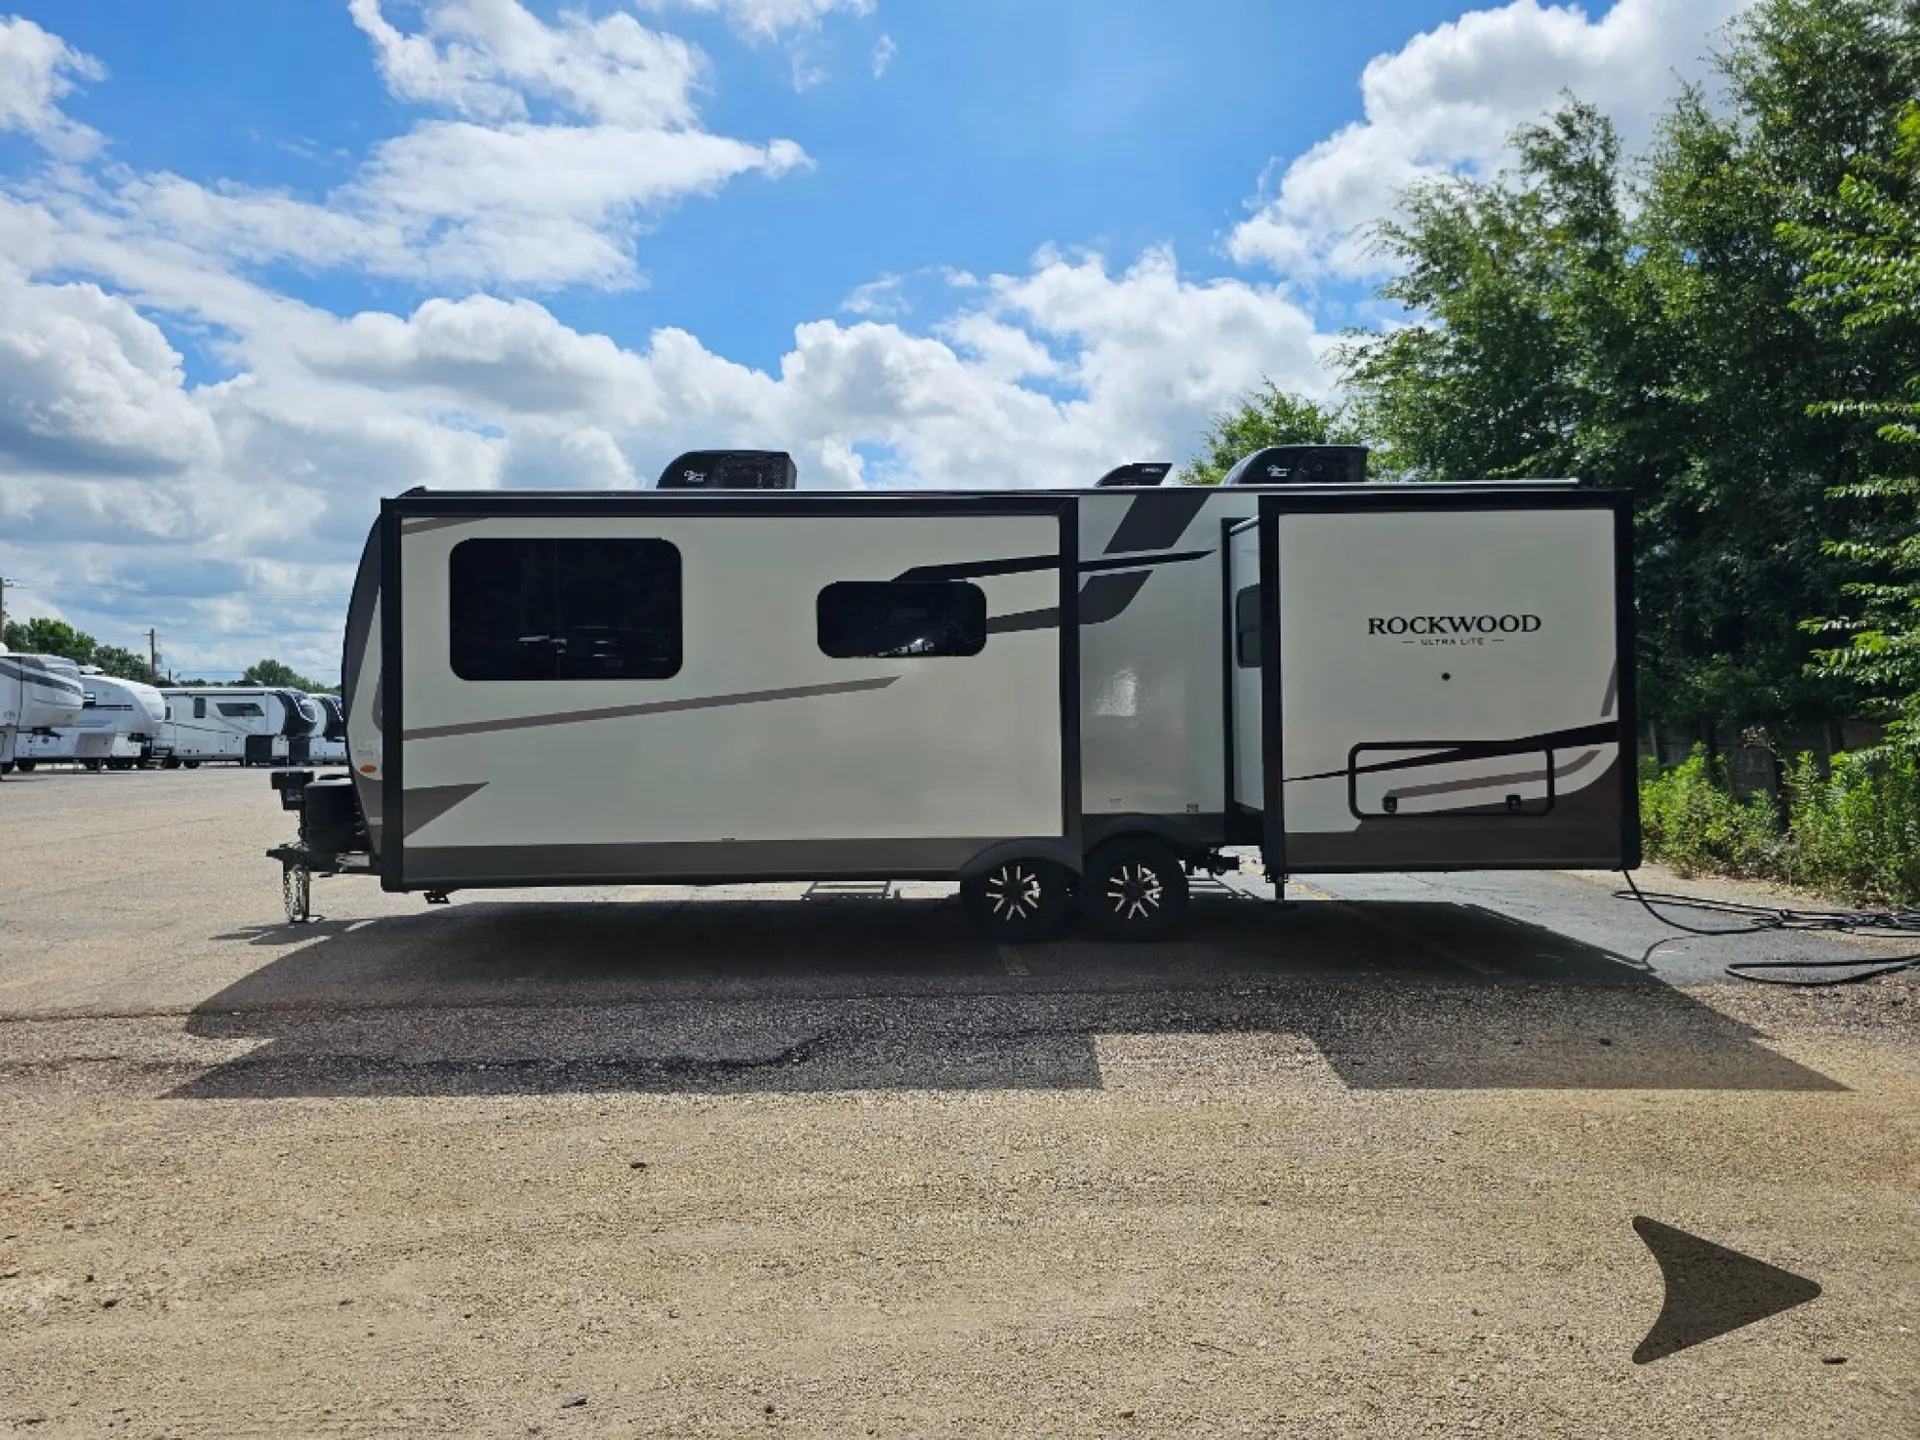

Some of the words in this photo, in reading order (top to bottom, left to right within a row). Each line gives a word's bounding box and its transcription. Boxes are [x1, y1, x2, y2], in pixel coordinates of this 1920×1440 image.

[1368, 614, 1542, 635] ROCKWOOD
[1420, 638, 1456, 646] ULTRA
[1460, 637, 1484, 646] LITE
